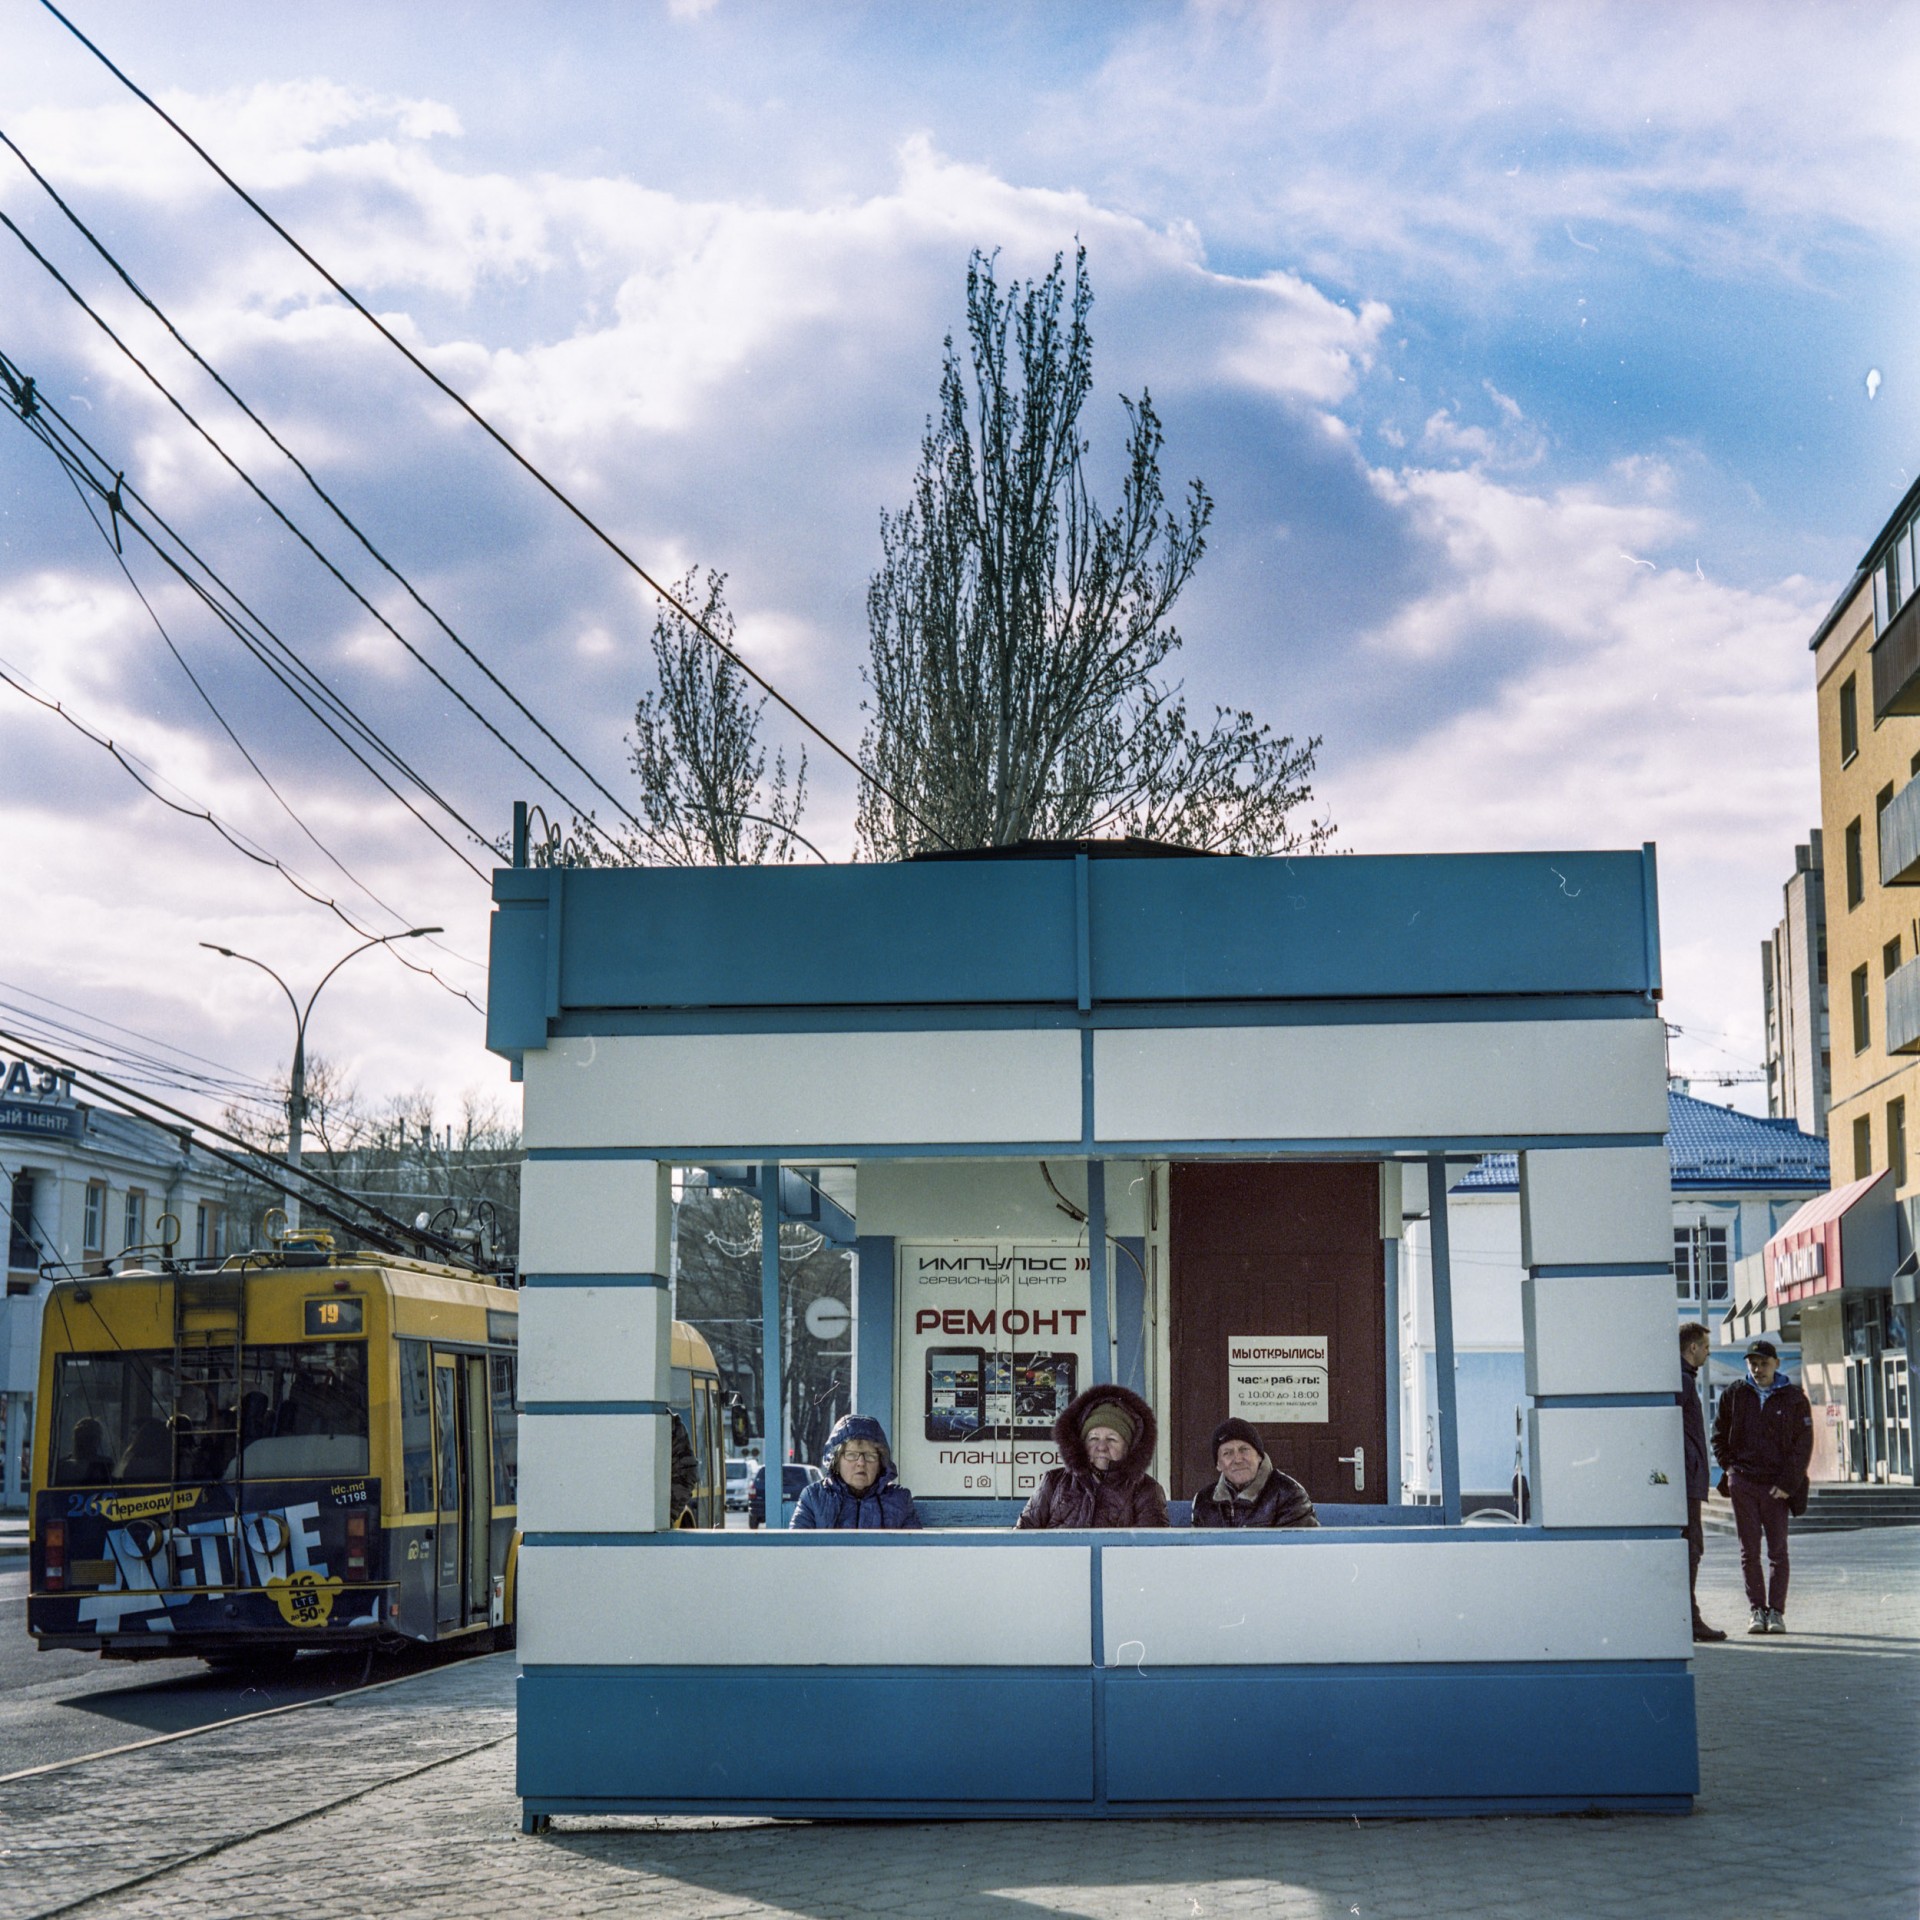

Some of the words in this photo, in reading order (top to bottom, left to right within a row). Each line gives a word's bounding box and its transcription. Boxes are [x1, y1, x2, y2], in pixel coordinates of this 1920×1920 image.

[27, 1112, 69, 1130] ЦЕНТР
[919, 1257, 1067, 1271] ИМПУЛЬС
[318, 1303, 339, 1324] 19
[916, 1309, 1087, 1335] РЕМОНТ
[1232, 1348, 1251, 1359] МЫ
[1253, 1348, 1325, 1359] ОТКРЫЛИСЬ!
[1293, 1390, 1320, 1399] 18:00
[331, 1481, 365, 1495] idc.md
[109, 1497, 171, 1516] Переходи
[176, 1491, 193, 1504] на
[341, 1491, 367, 1503] 1198
[289, 1575, 317, 1597] 4G
[295, 1596, 315, 1608] LTE
[299, 1606, 318, 1622] 50
